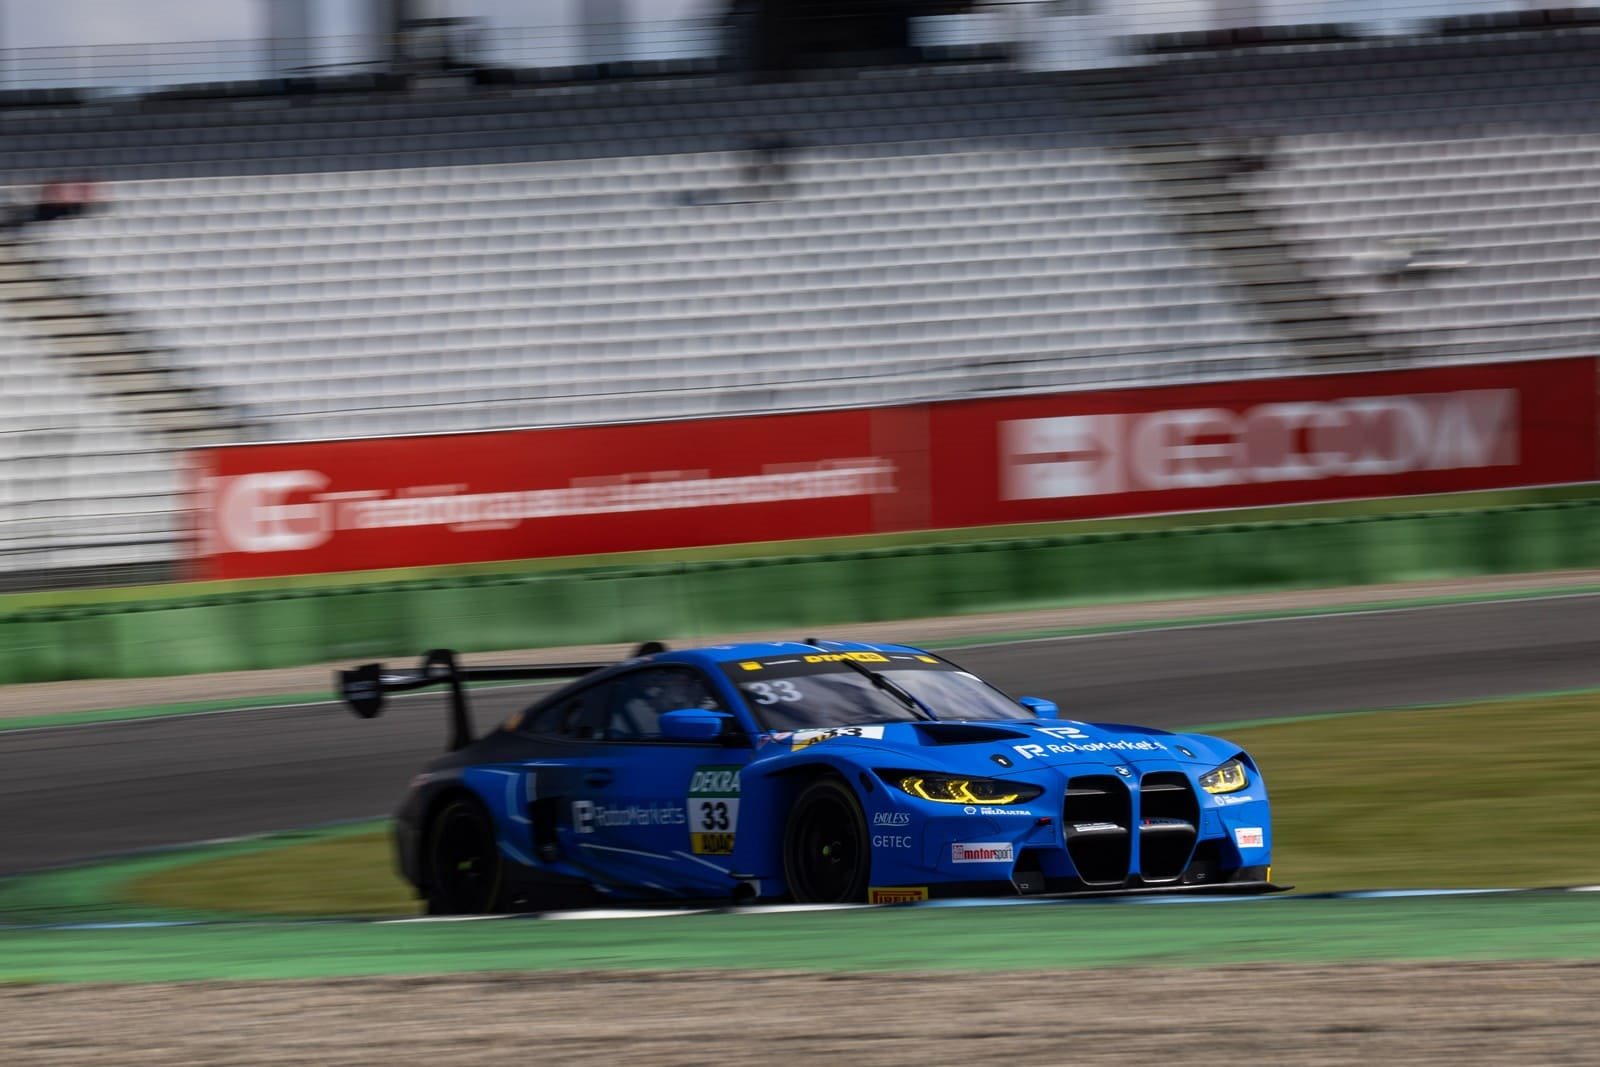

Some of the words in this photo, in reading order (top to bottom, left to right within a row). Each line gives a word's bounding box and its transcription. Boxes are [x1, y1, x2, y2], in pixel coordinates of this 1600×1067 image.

[748, 680, 803, 705] 33
[1046, 741, 1168, 755] RoboMarkets
[689, 771, 741, 793] DEKRA
[701, 801, 730, 831] 33
[873, 811, 912, 824] ENDLESS
[873, 834, 912, 849] GETEC
